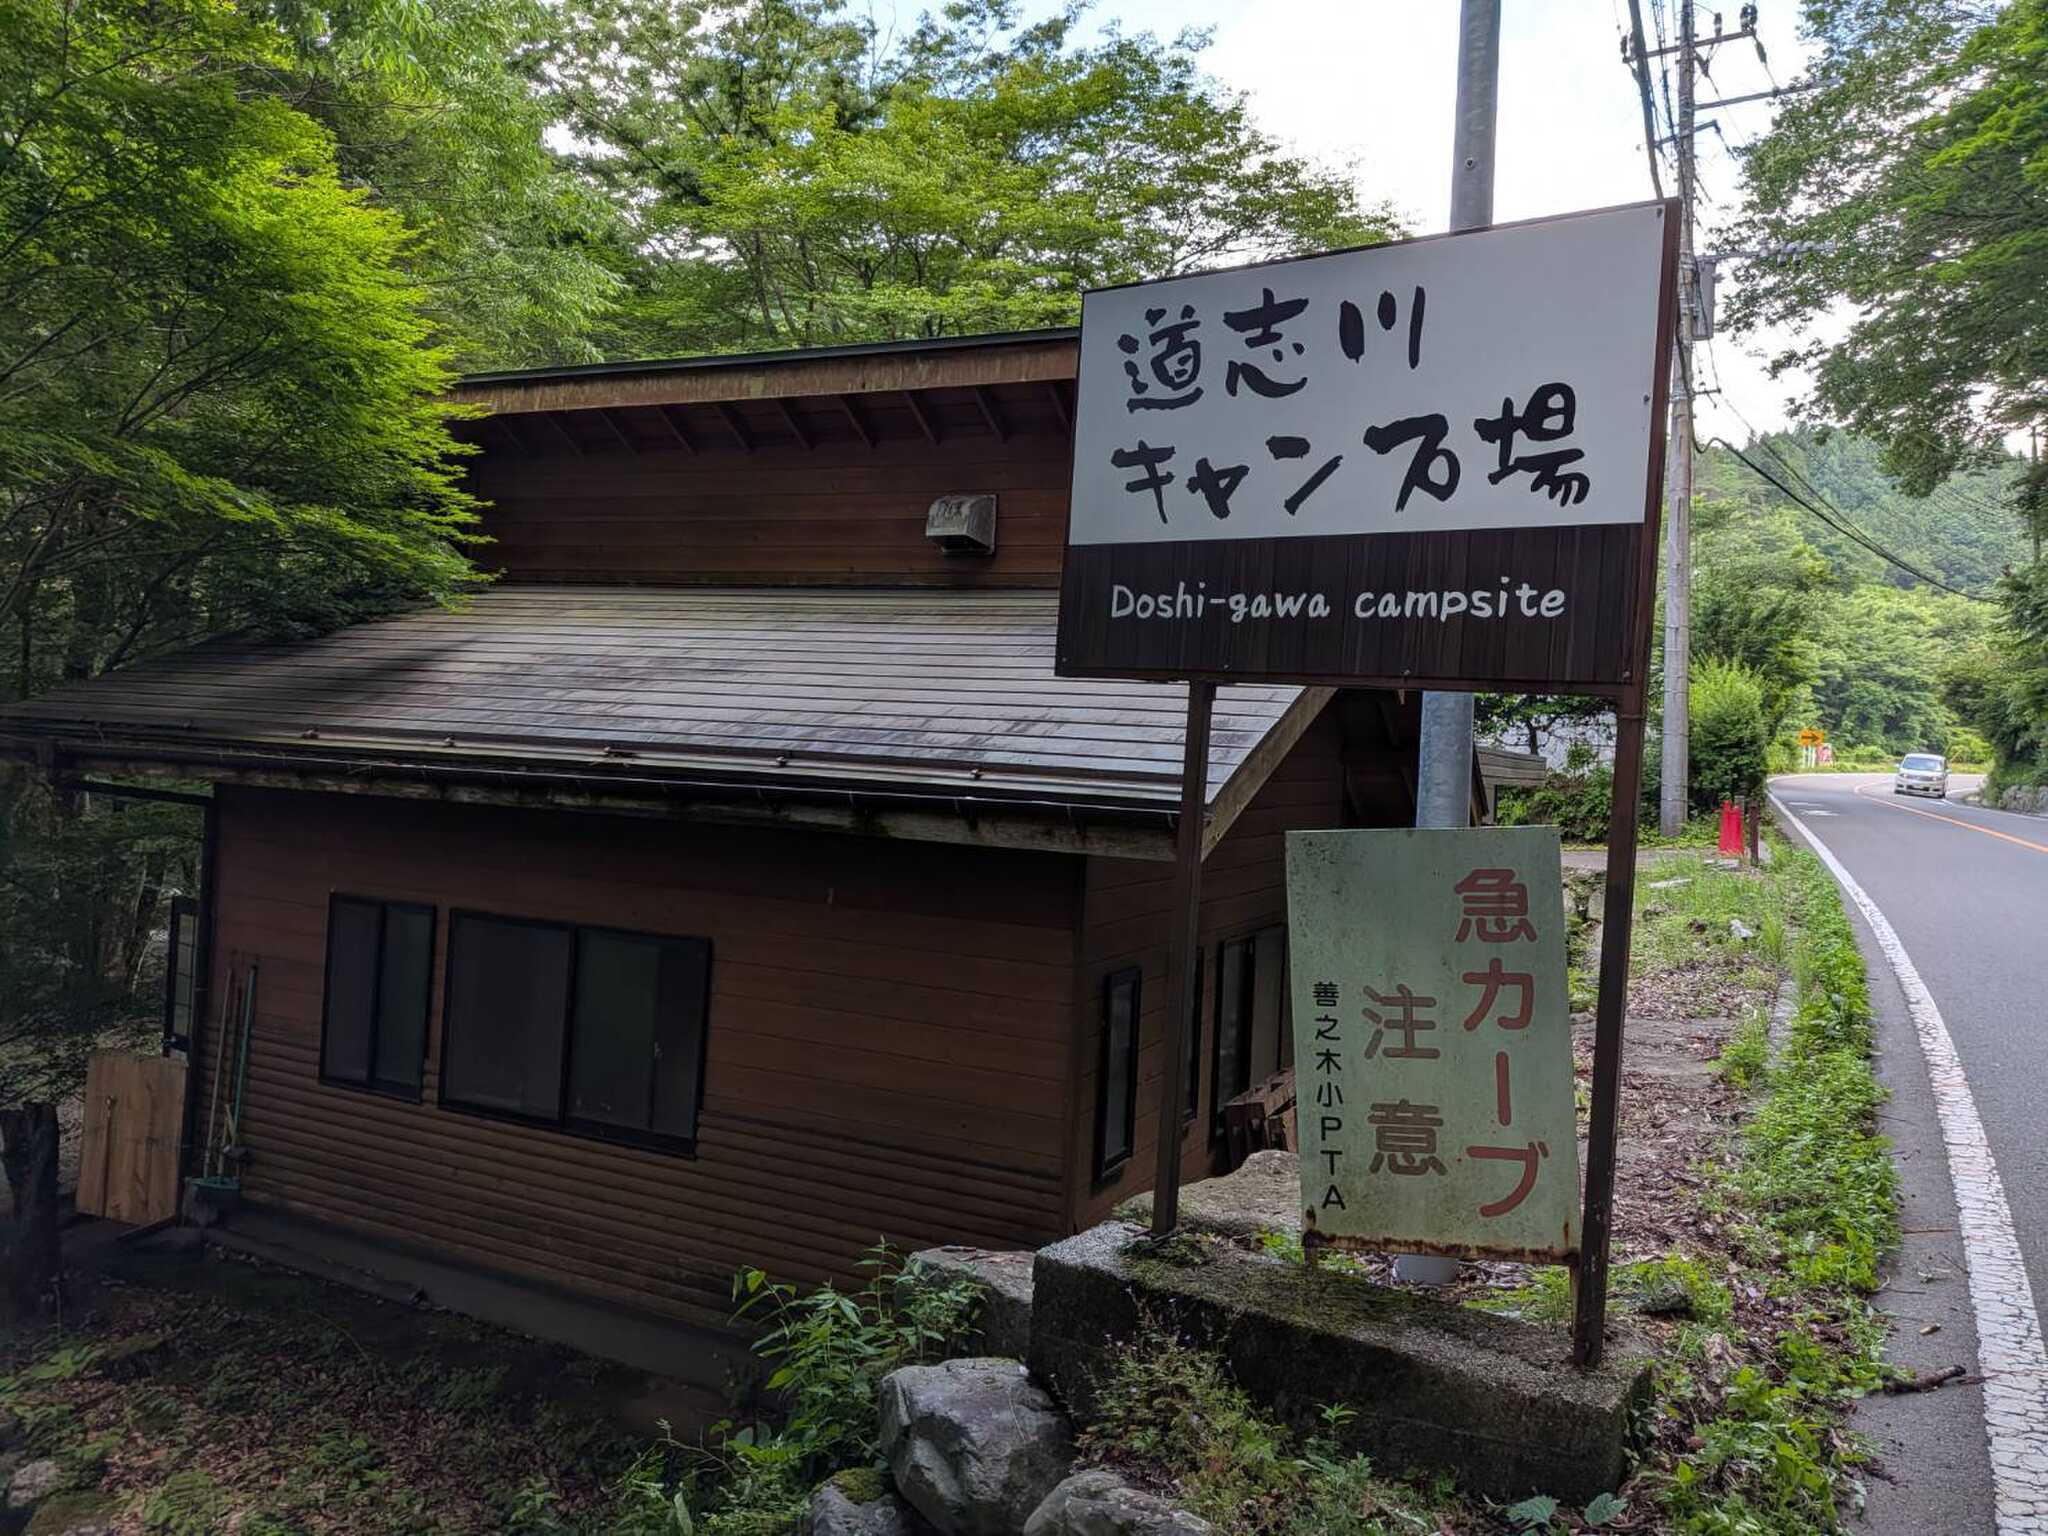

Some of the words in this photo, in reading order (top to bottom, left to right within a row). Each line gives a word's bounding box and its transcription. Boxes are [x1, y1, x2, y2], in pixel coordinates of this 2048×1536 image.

[1118, 286, 1425, 412] 道志川
[1111, 383, 1590, 524] キャンプ場
[1110, 581, 1331, 622] Doshi-gawa
[1354, 576, 1566, 622] campsite
[1312, 981, 1347, 1211] 善之木小PTA
[1362, 983, 1448, 1176] 注意
[1454, 868, 1550, 1218] 急カーブ
